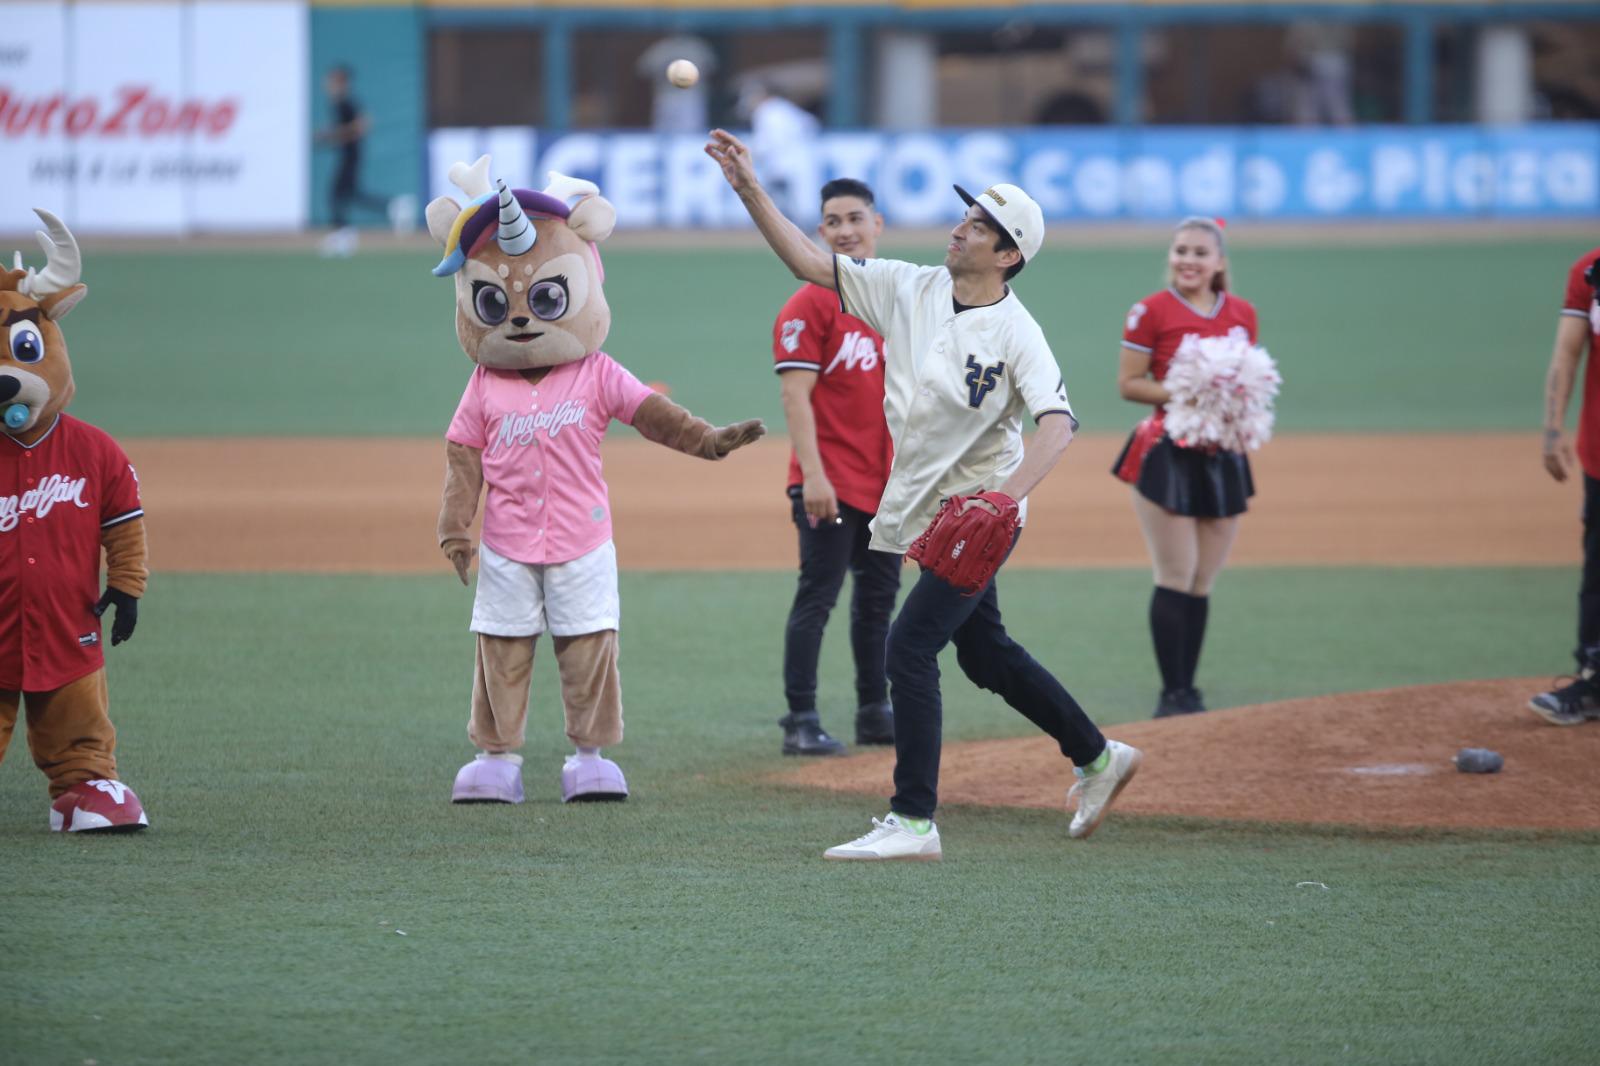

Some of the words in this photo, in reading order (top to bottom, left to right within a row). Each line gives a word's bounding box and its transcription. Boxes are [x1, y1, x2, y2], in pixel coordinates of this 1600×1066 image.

[0, 84, 240, 138] utoZone
[1304, 147, 1364, 213] &
[1372, 140, 1596, 212] Plaza
[489, 399, 587, 455] Mazatlán
